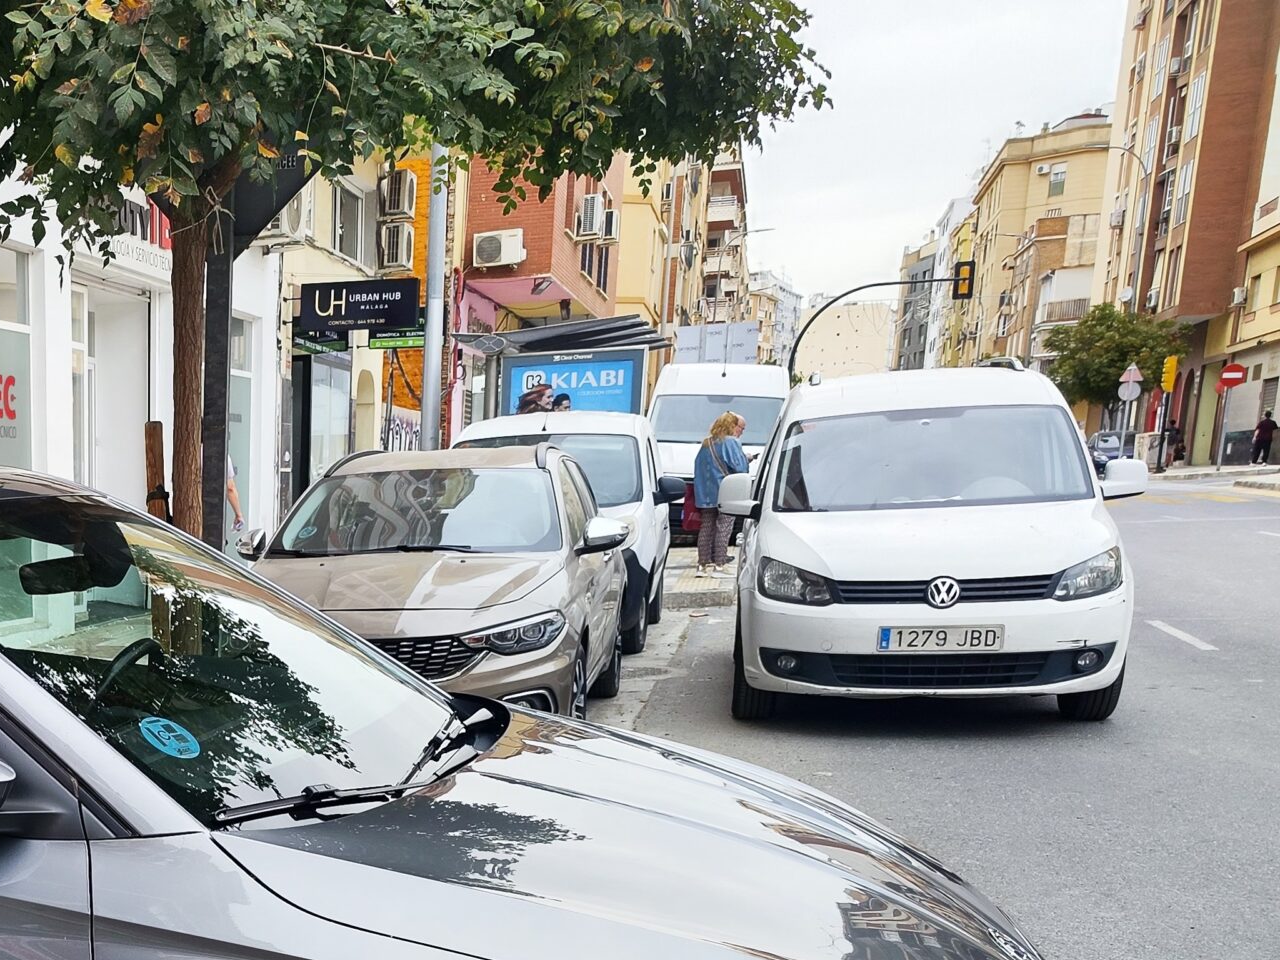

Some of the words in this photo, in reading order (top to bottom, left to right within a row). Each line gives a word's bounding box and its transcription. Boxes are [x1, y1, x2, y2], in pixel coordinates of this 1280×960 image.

[349, 293, 380, 303] URBAN
[382, 292, 402, 301] HUB
[551, 369, 625, 390] KIABI
[896, 629, 948, 648] 1279
[956, 629, 997, 648] JBD
